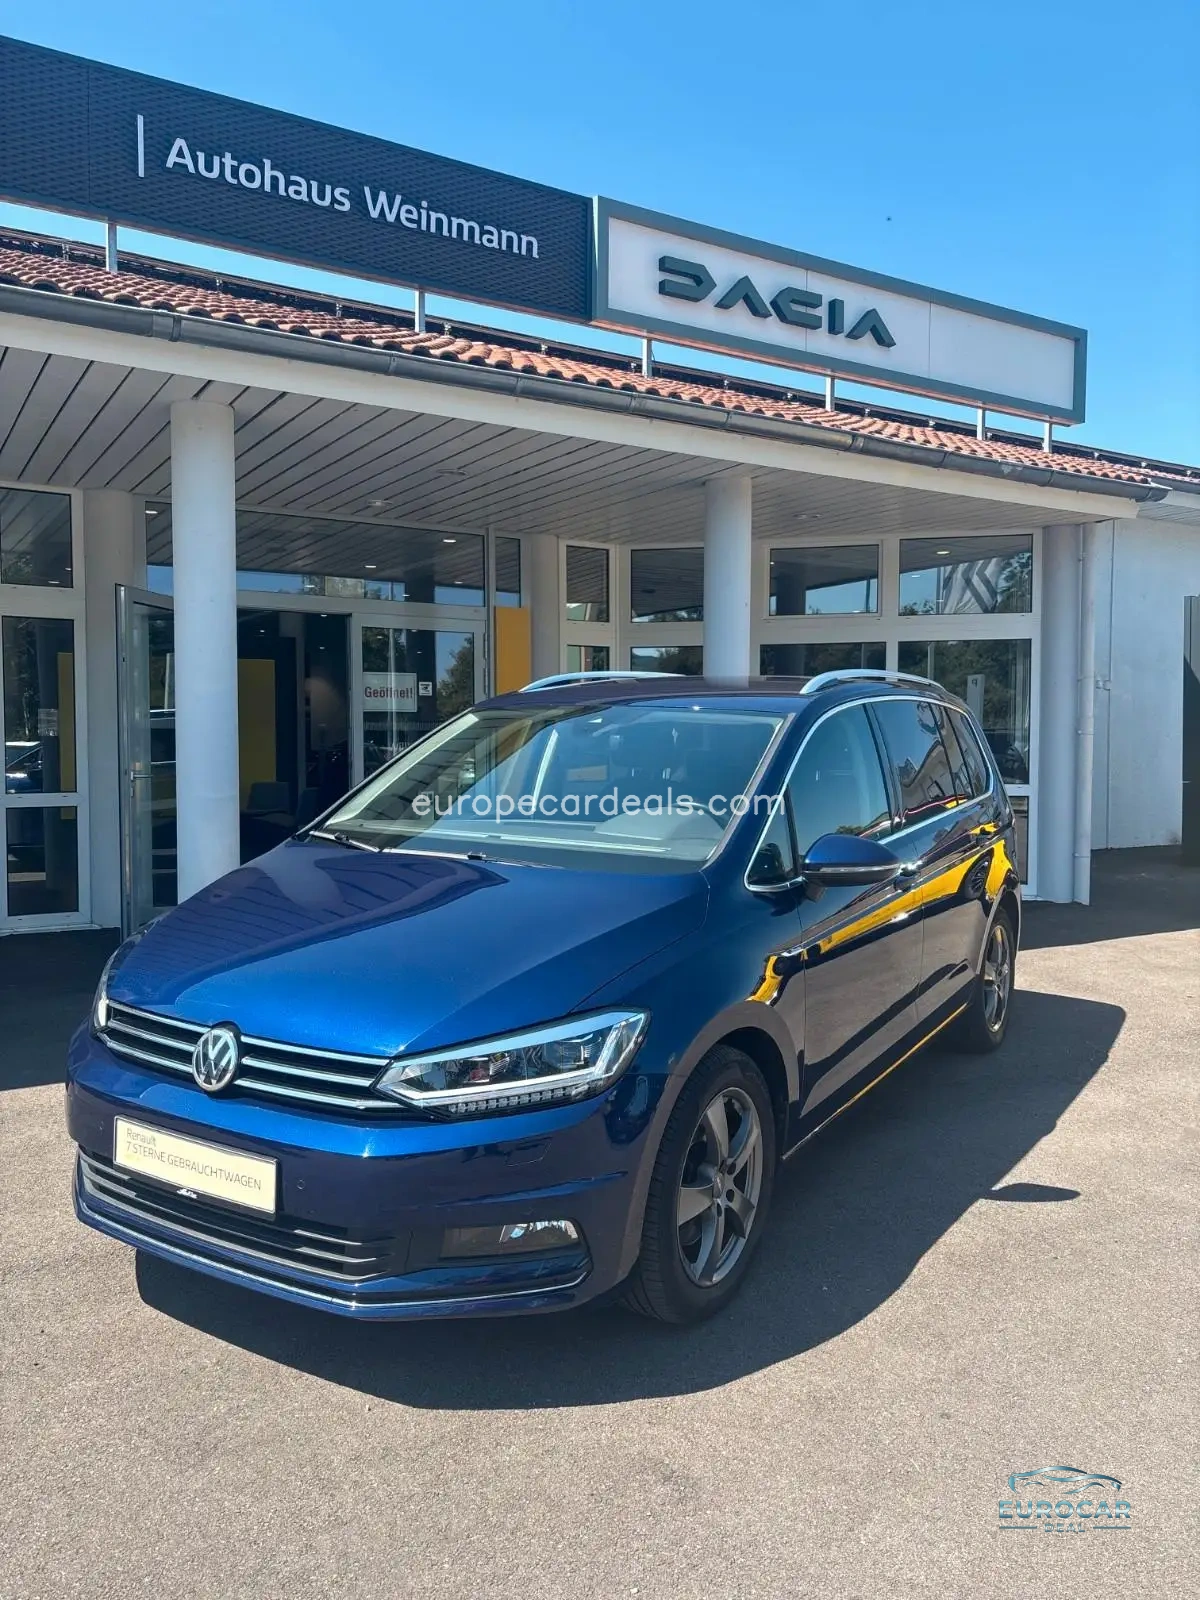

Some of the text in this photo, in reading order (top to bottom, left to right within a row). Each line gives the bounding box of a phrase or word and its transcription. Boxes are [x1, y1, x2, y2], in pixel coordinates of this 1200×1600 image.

[165, 138, 540, 259] Autohaus Weinmann
[658, 255, 897, 348] DACIA
[126, 1128, 157, 1147] Renault
[126, 1141, 262, 1190] 7 STERNE GEBRAUCHTWAGEN
